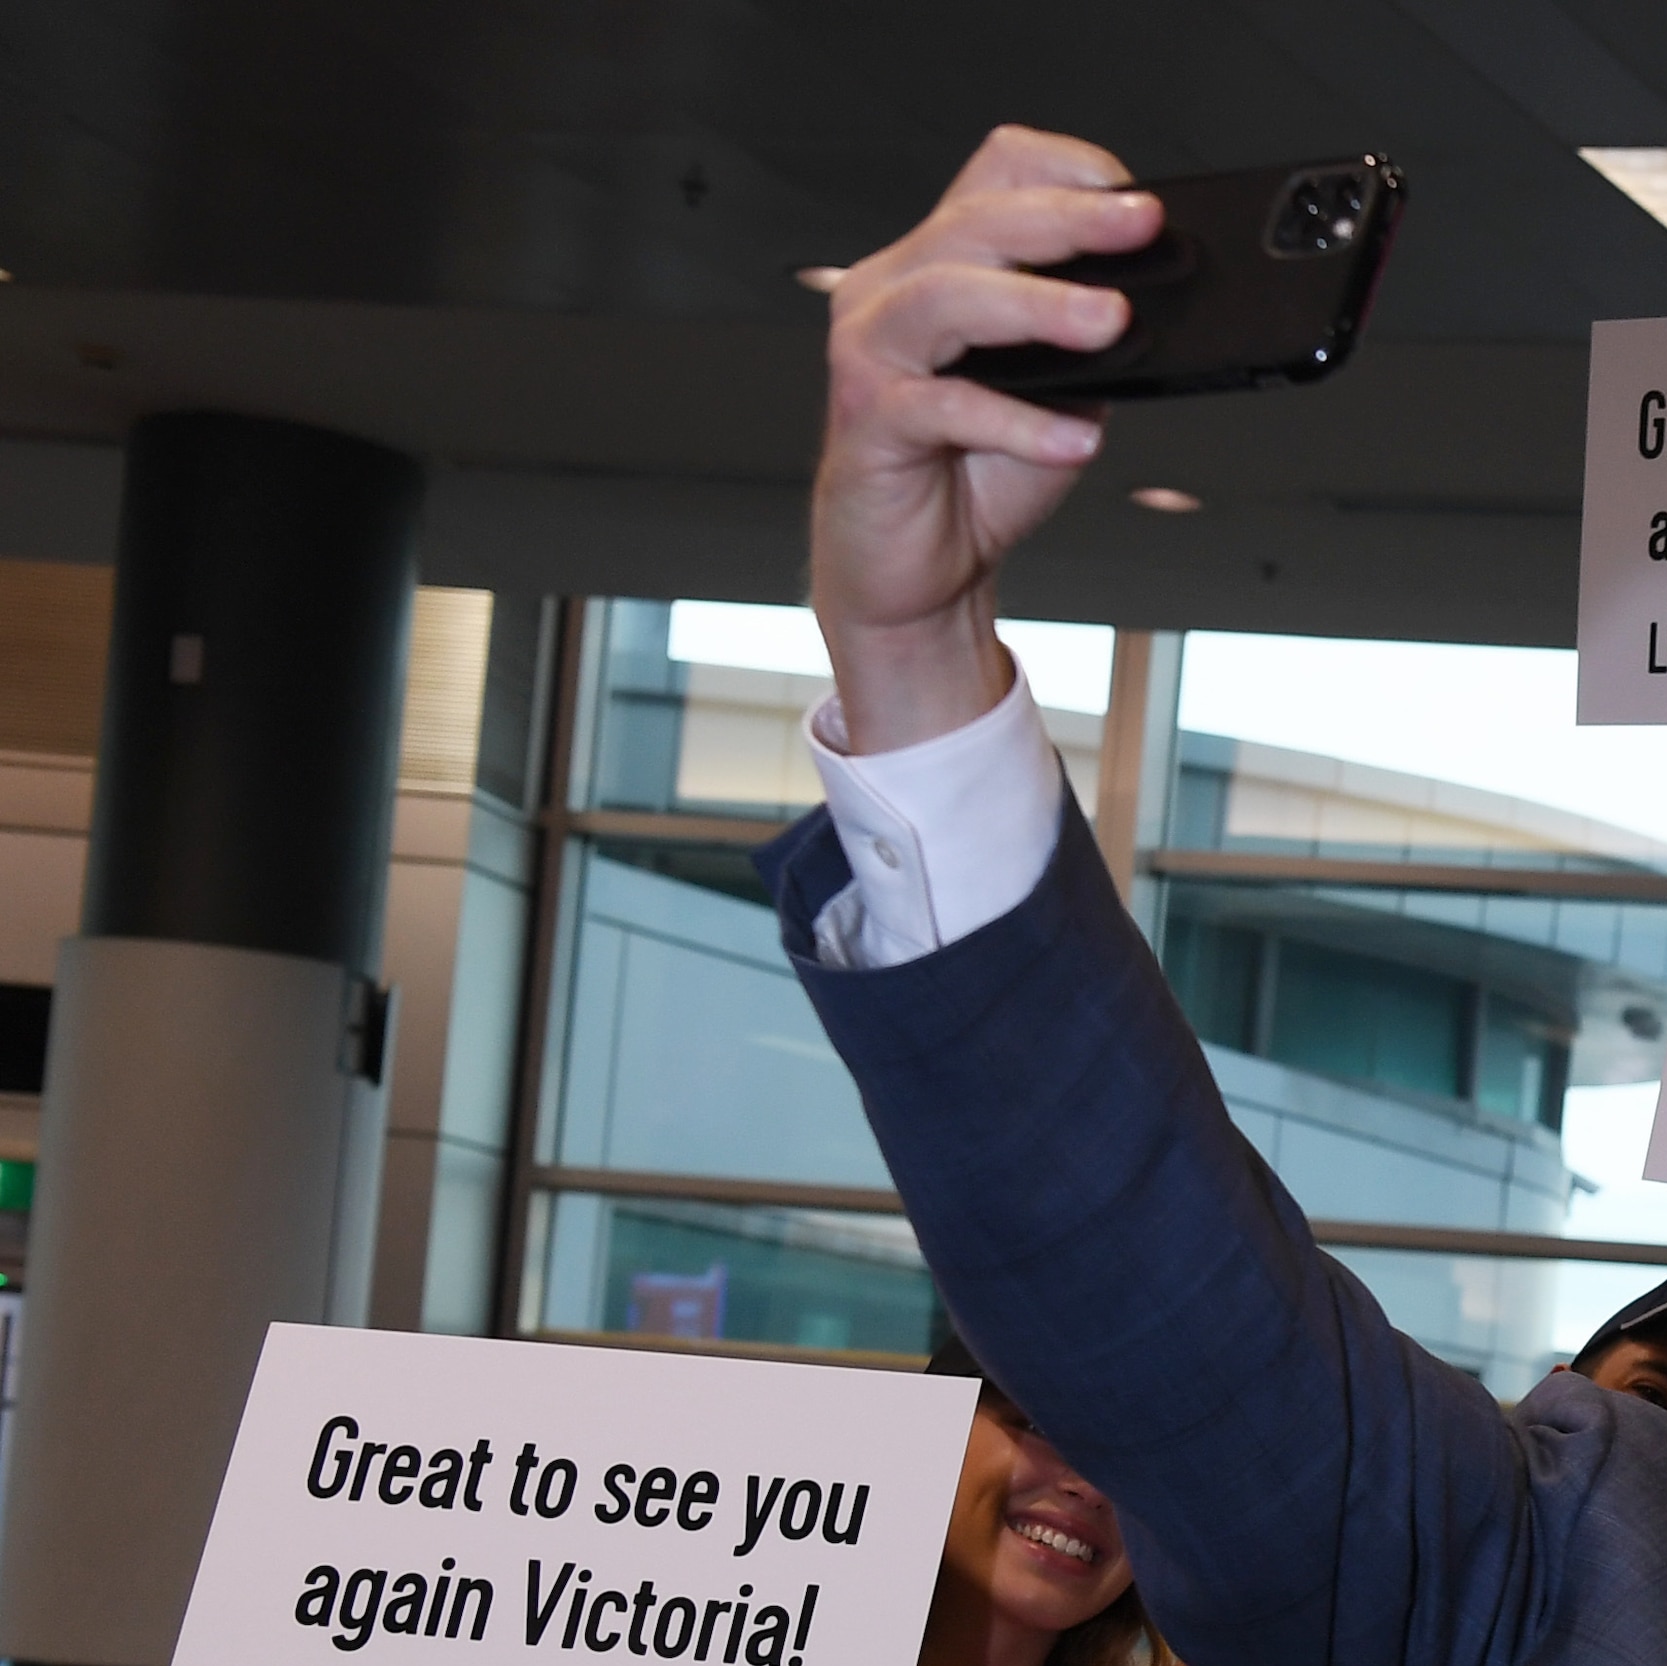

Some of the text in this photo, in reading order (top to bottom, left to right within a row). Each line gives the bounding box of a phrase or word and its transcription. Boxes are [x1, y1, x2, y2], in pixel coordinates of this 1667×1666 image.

[307, 1415, 871, 1557] Great to see you
[294, 1557, 494, 1652] again
